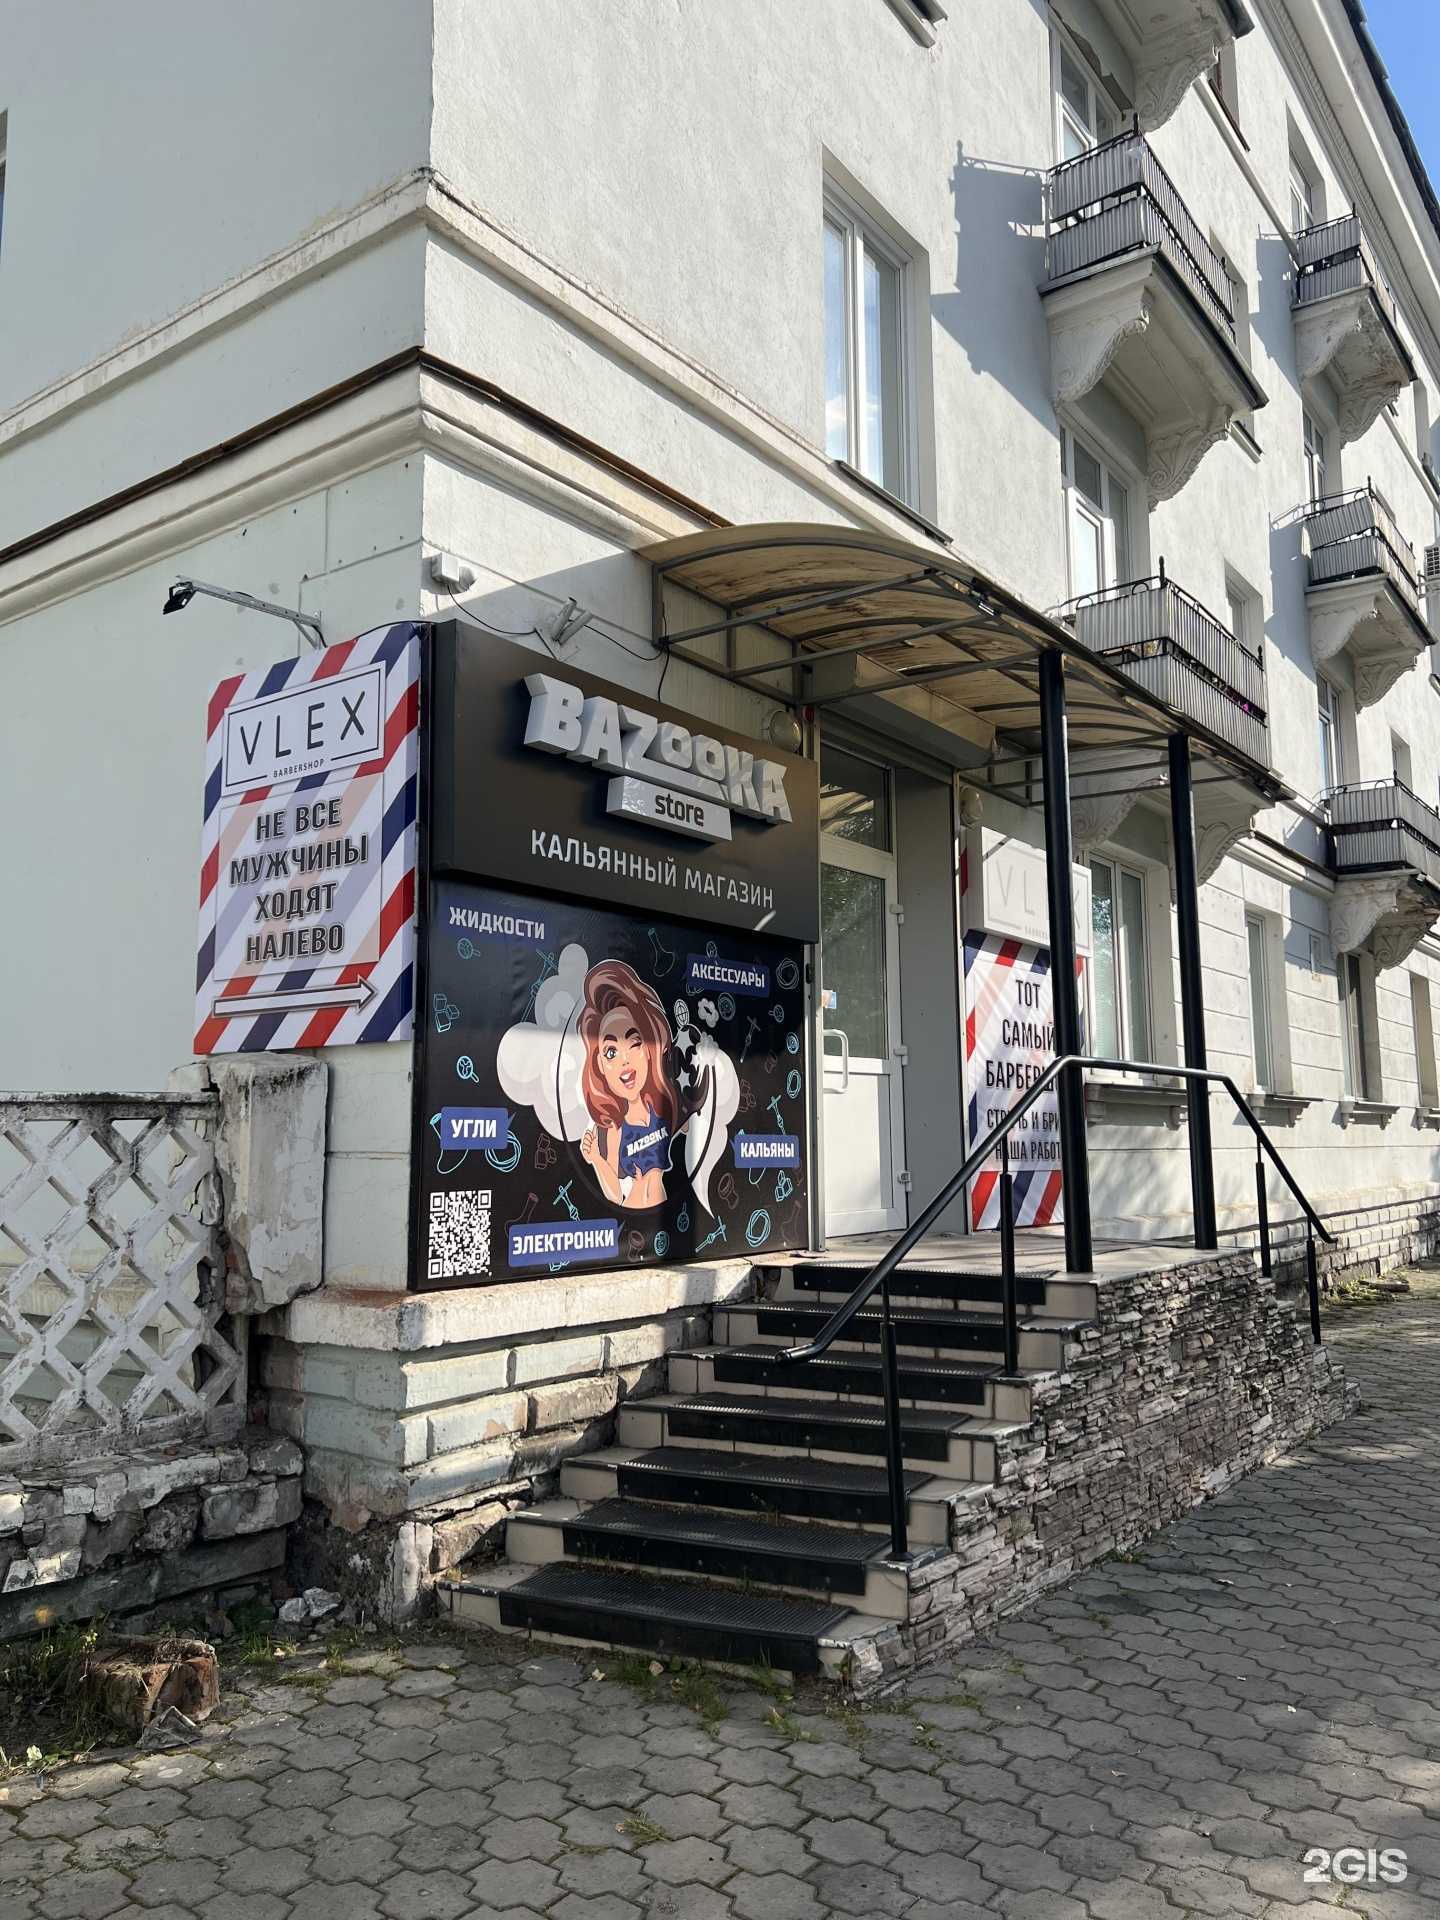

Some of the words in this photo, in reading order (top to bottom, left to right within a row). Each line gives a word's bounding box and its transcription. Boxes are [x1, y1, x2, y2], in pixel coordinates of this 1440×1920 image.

[239, 690, 365, 765] VLEX
[524, 673, 793, 824] BAZOOKA
[273, 759, 325, 778] BARBERSHOP
[256, 810, 285, 842] НЕ
[295, 797, 342, 832] ВСЕ
[655, 792, 704, 827] store
[230, 835, 368, 887] МУЖЧИНЫ
[531, 829, 677, 888] КАЛЬЯННЫЙ
[684, 868, 775, 909] МАГАЗИН
[255, 882, 337, 921] ХОДЯТ
[449, 906, 546, 940] ЖИДКОСТИ
[246, 923, 344, 963] НАЛЕВО
[691, 962, 765, 988] АКСЕССУАРЫ
[1015, 979, 1041, 1009] ТОТ
[1002, 1018, 1055, 1051] САМЫЙ
[451, 1119, 498, 1139] УГЛИ
[1031, 1112, 1040, 1130] И
[626, 1126, 669, 1157] BAZOOKA
[740, 1141, 795, 1159] КАЛЬЯНЫ
[995, 1141, 1028, 1160] НША
[1031, 1141, 1061, 1160] РАБОТ
[512, 1228, 615, 1255] ЭЛЕКТРОНКИ
